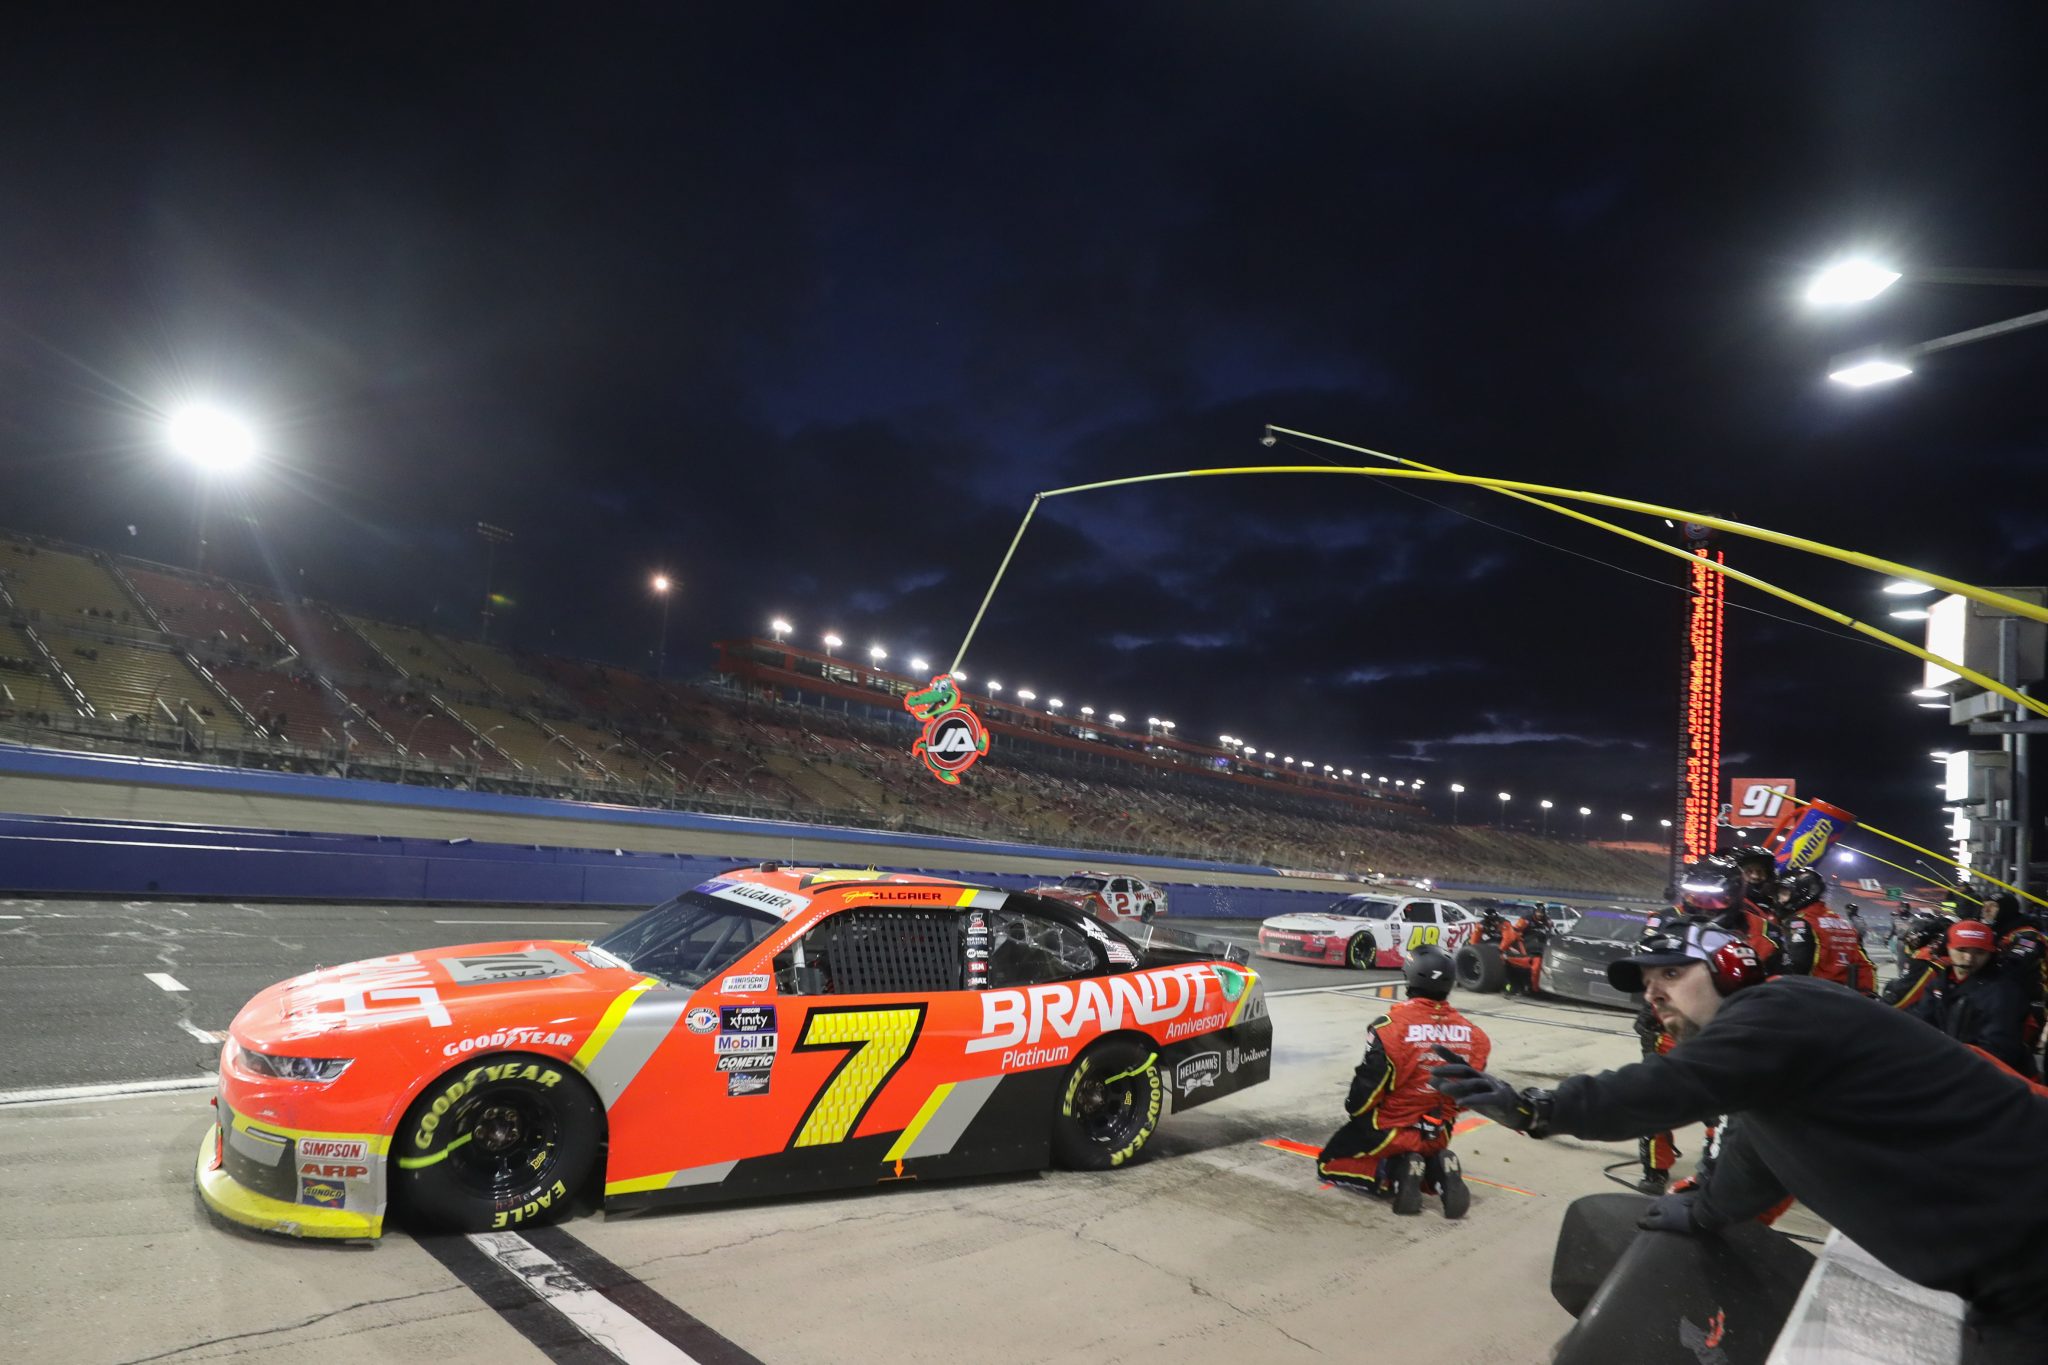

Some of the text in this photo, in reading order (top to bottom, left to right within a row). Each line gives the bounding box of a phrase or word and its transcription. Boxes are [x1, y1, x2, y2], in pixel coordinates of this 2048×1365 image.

[927, 728, 977, 752] JA
[1739, 785, 1788, 817] 91
[729, 886, 793, 908] ALLGAIER
[1115, 893, 1131, 914] 2
[1407, 925, 1440, 951] 48
[1431, 970, 1443, 980] 7
[965, 965, 1212, 1054] BRANDT
[729, 1014, 768, 1029] xfinity
[1165, 1012, 1228, 1039] Anniversary
[1404, 1023, 1472, 1042] BRANDT
[443, 1027, 573, 1056] GOODYEAR
[718, 1035, 771, 1049] Mobil 1
[718, 1055, 774, 1069] COMETIC
[1001, 1045, 1069, 1070] Platinum
[1180, 1055, 1218, 1079] HELLMANN'S
[1241, 1048, 1269, 1064] Unilever
[789, 1002, 928, 1151] 7
[415, 1063, 562, 1149] GOODYEAR
[302, 1142, 362, 1158] SIMPSON
[301, 1163, 368, 1178] ARP
[304, 1187, 345, 1199] SUNOCO
[491, 1179, 567, 1228] EAGLE
